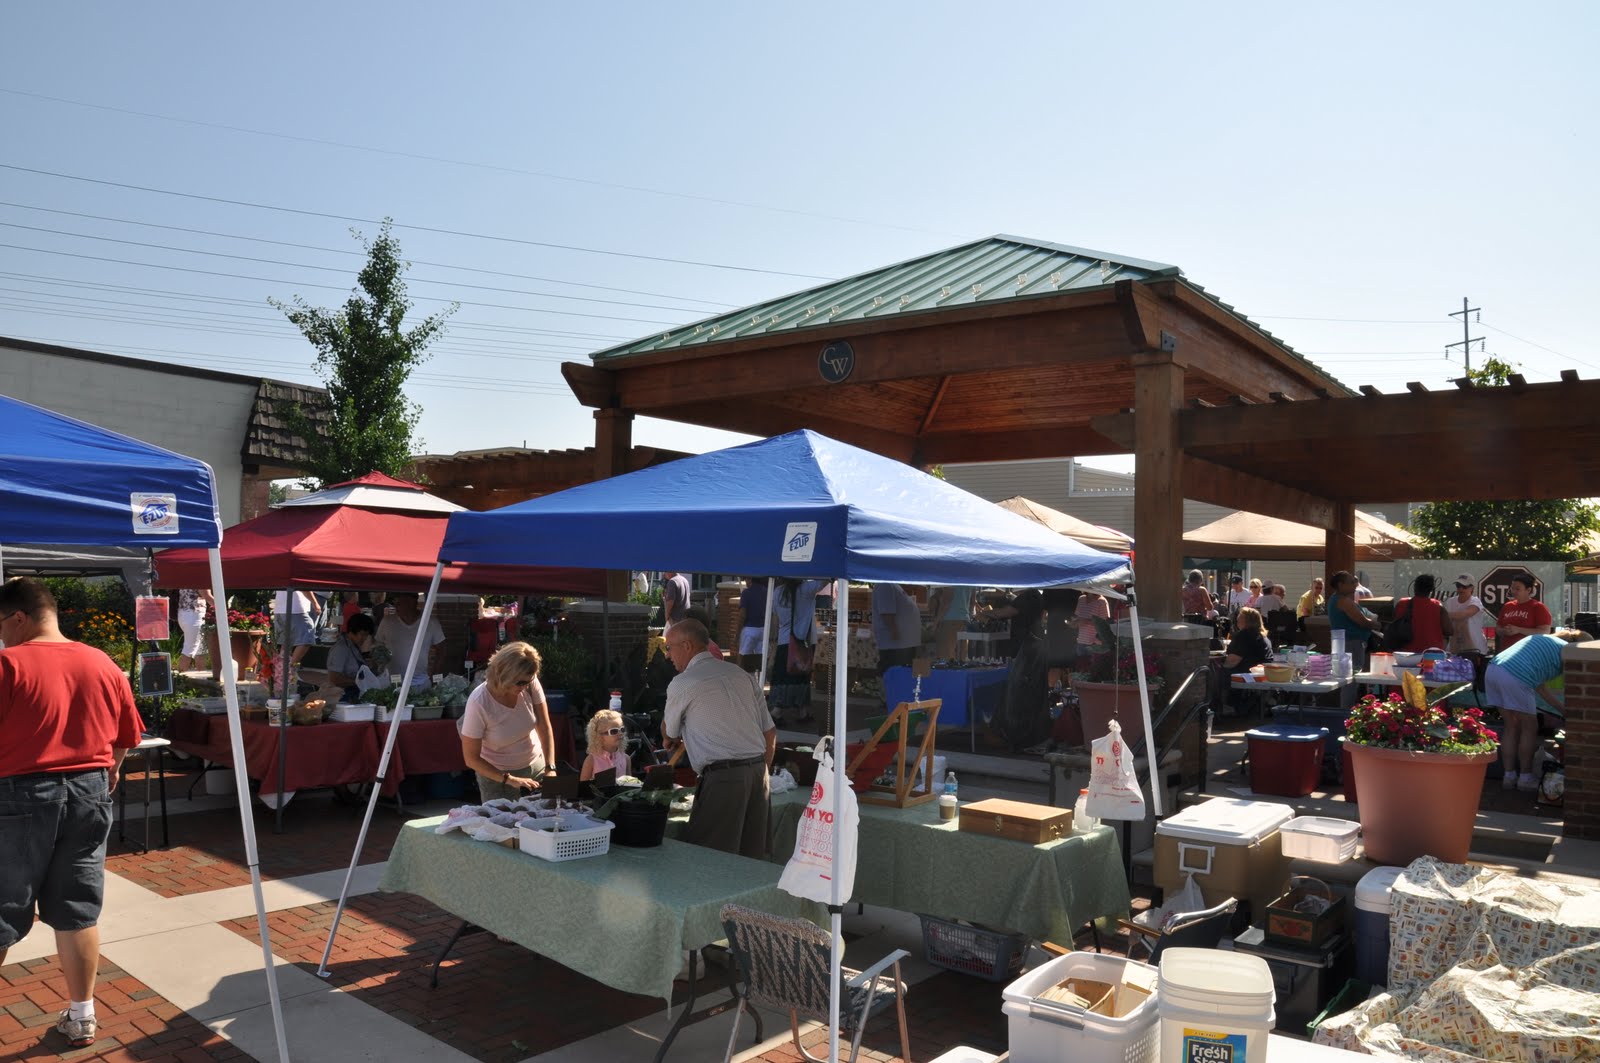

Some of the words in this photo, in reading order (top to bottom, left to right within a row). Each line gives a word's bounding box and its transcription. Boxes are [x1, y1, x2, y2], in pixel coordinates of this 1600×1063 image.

[1504, 610, 1528, 619] MIAMI
[819, 810, 833, 824] YO
[1192, 1044, 1229, 1060] Fresh
